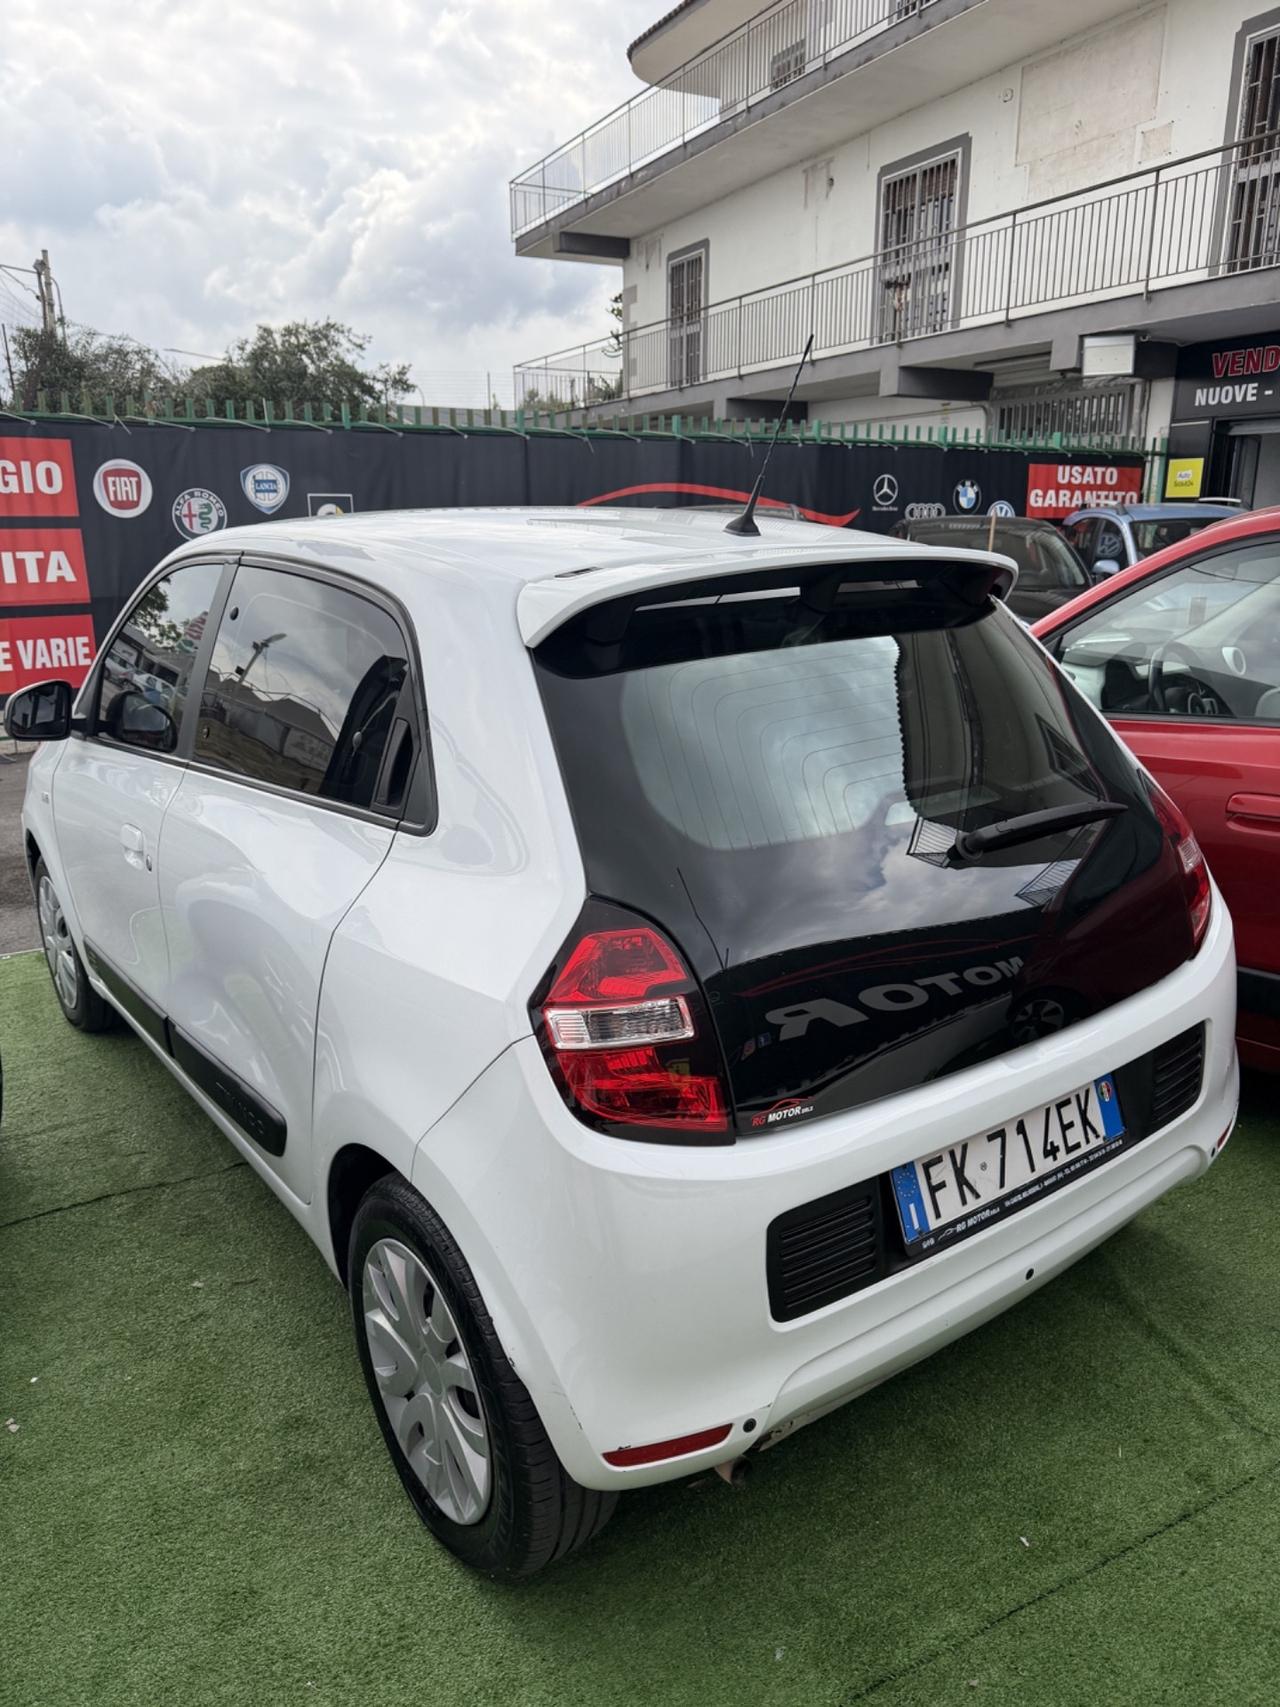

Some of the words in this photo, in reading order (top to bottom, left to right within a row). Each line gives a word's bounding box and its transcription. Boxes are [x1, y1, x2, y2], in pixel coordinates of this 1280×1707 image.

[1211, 344, 1280, 378] VEND
[1194, 383, 1258, 406] NUOVE
[0, 460, 63, 495] GIO
[1057, 464, 1118, 485] USATO
[107, 476, 139, 502] FIAT
[1029, 489, 1138, 508] GARANTITO
[175, 494, 191, 517] ALFA
[194, 491, 224, 517] ROMEO
[2, 551, 77, 584] ITA
[16, 636, 92, 670] VARIE
[752, 1115, 766, 1127] RG
[767, 1106, 801, 1123] MOTOR
[921, 1142, 981, 1219] FK
[986, 1088, 1100, 1189] 714EK
